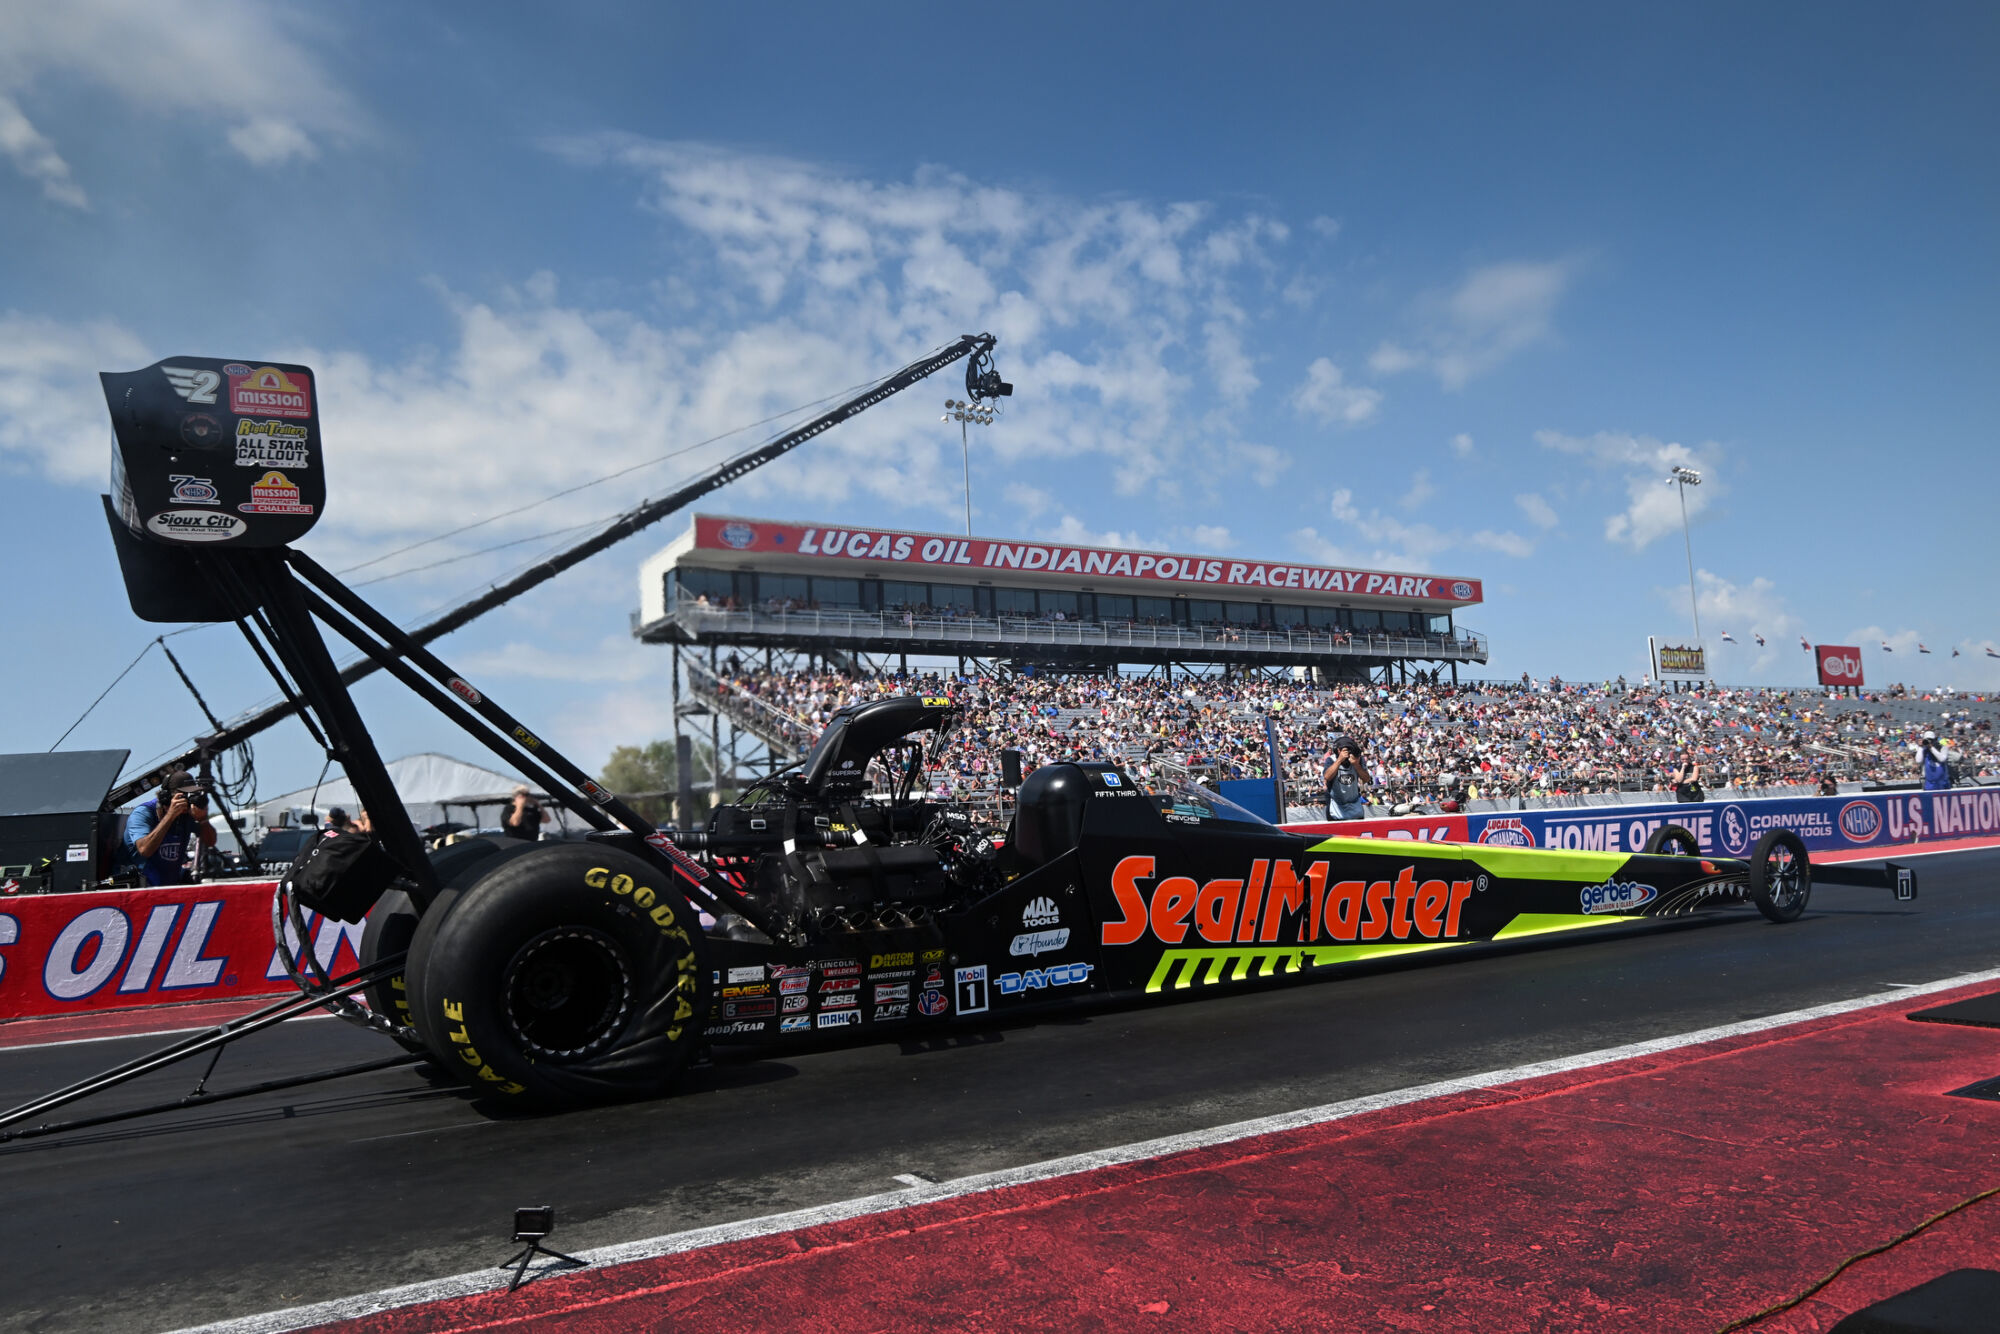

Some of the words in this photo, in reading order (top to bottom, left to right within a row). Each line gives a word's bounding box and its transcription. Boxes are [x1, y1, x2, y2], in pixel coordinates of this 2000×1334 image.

[187, 370, 220, 404] 2
[239, 438, 264, 449] ALL
[269, 440, 304, 450] STAR
[239, 449, 304, 461] CALLOUT
[183, 487, 207, 496] NHRA
[257, 504, 311, 514] CHALLENGE
[158, 513, 201, 526] Sioux
[206, 515, 239, 528] City
[798, 528, 912, 561] LUCAS
[921, 538, 972, 565] OIL
[983, 543, 1222, 583] INDIANAPOLIS
[1227, 562, 1363, 592] RACEWAY
[1365, 573, 1432, 598] PARK
[452, 680, 477, 701] BELL
[922, 697, 950, 707] PJH
[946, 811, 967, 821] MSD
[1750, 813, 1831, 829] CORNWELL
[1845, 804, 1877, 834] NHRA
[1887, 797, 1929, 839] U.S.
[1487, 820, 1509, 830] LUCAS
[1510, 819, 1522, 828] OIL
[1799, 826, 1832, 837] TOOLS
[1544, 822, 1621, 852] HOME
[976, 838, 989, 854] MSD
[1101, 855, 1474, 946] SealMaster
[1581, 878, 1637, 914] gerber
[1022, 896, 1060, 919] MAC
[1592, 904, 1615, 912] COLLISION
[1022, 916, 1060, 928] TOOLS
[42, 900, 229, 1001] OIL
[819, 960, 855, 969] LINCOLN
[827, 967, 859, 976] WELDERS
[957, 968, 985, 982] Mobil
[996, 963, 1091, 994] DAYCO
[820, 980, 860, 992] ARP
[876, 987, 908, 999] CHAMPION
[821, 994, 858, 1007] JESEL
[966, 983, 977, 1008] 1
[874, 1003, 910, 1018] AJPE
[819, 1012, 860, 1026] MAHL
[442, 997, 528, 1095] EAGLE
